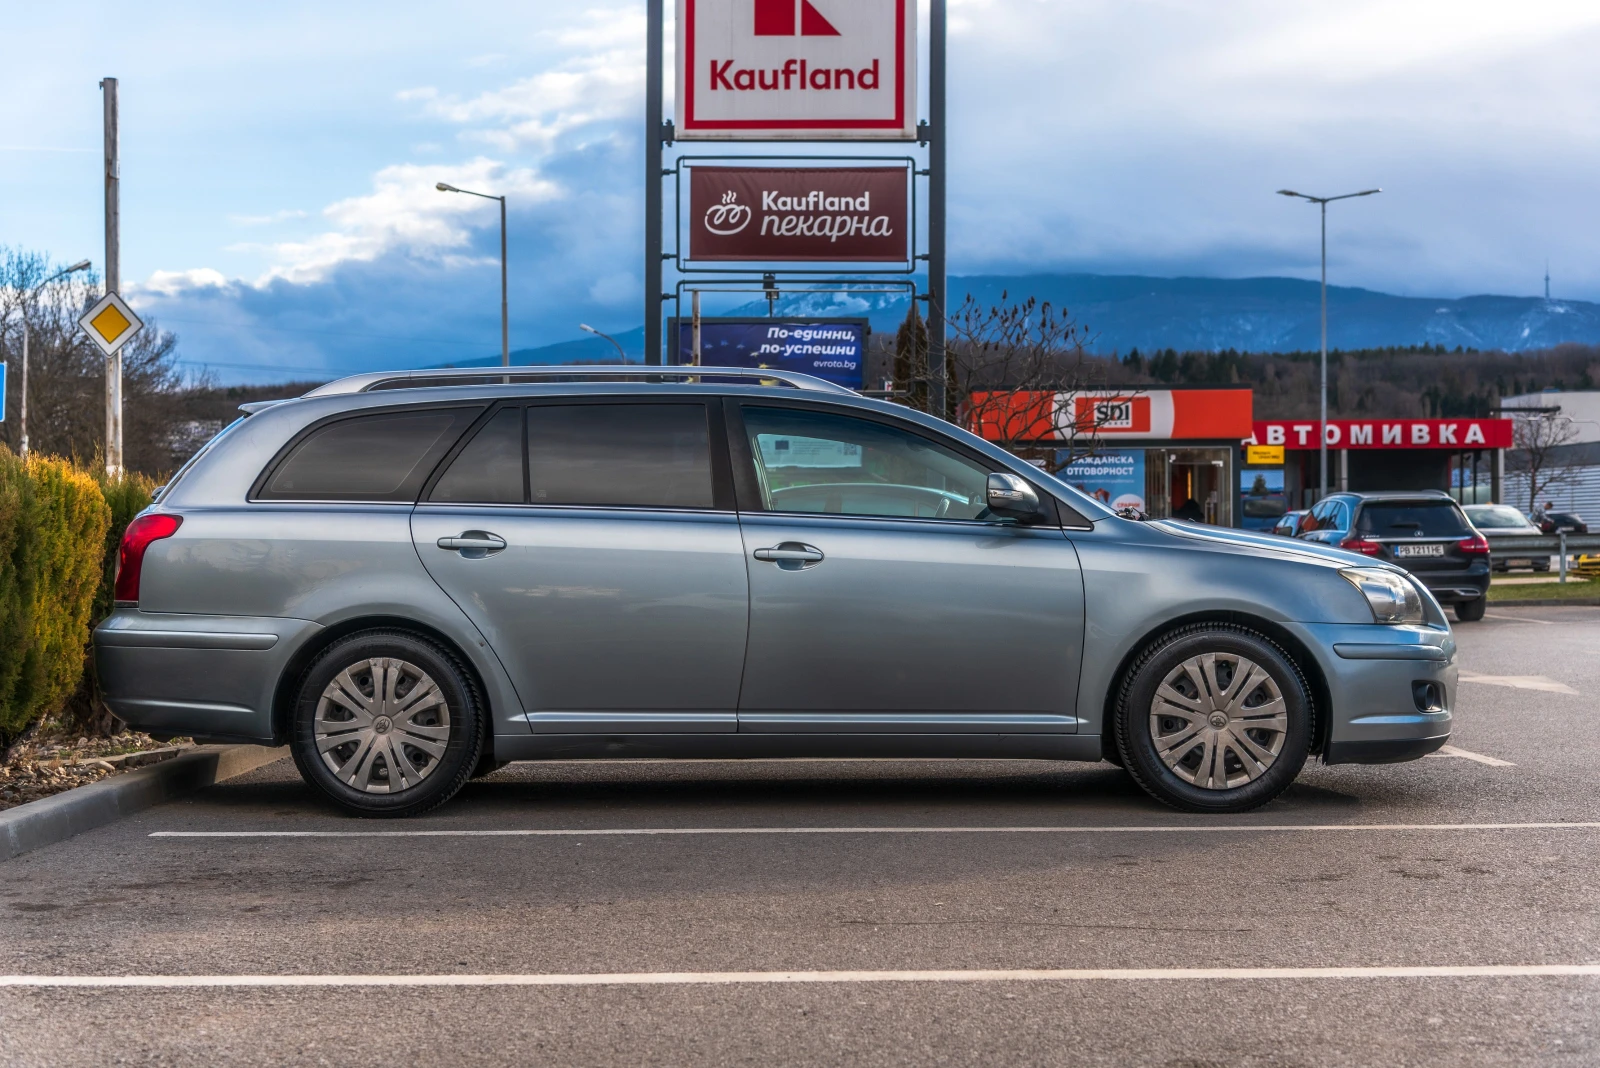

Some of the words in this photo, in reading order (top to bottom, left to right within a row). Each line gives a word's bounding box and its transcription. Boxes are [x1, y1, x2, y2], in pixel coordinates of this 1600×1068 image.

[710, 59, 879, 90] Kaufland
[762, 190, 870, 211] Kaufland
[760, 214, 893, 242] пекарна
[767, 327, 856, 342] По-единни,
[760, 343, 856, 356] по-успешни
[813, 360, 856, 370] evroto.bg
[1096, 404, 1130, 421] SDI
[1066, 466, 1134, 476] ОТГОВОРНОСТ
